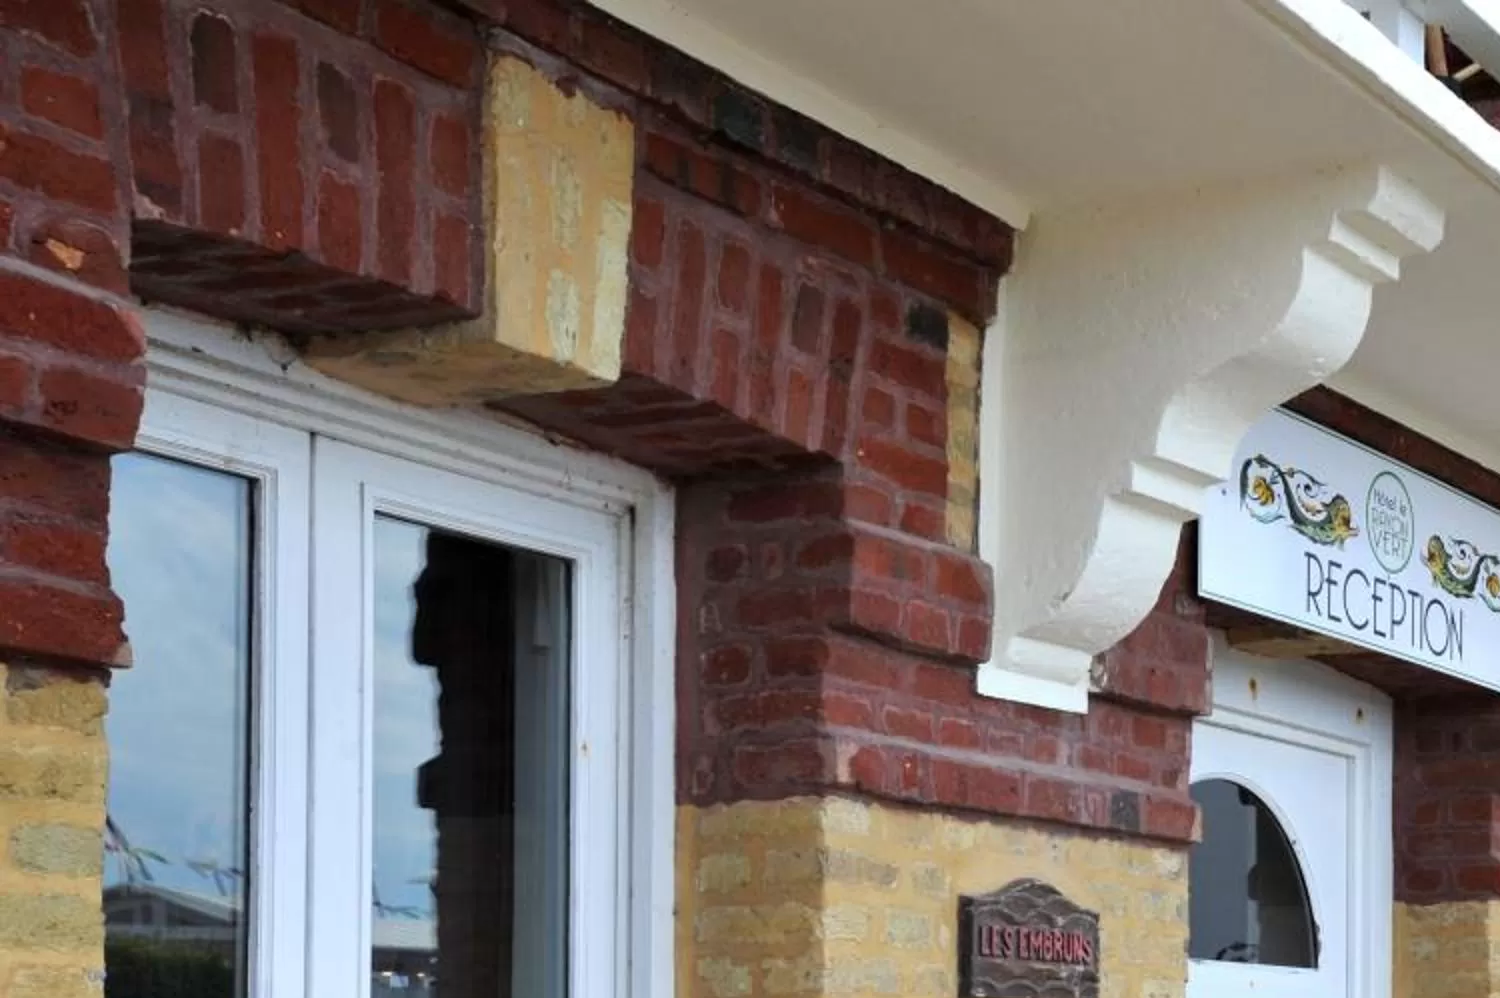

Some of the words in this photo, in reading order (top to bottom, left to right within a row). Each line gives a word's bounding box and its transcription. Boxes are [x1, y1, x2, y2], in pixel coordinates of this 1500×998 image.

[1303, 551, 1464, 661] RECEPTION
[980, 924, 1013, 961] LES
[1017, 925, 1093, 967] EMBRUNS
